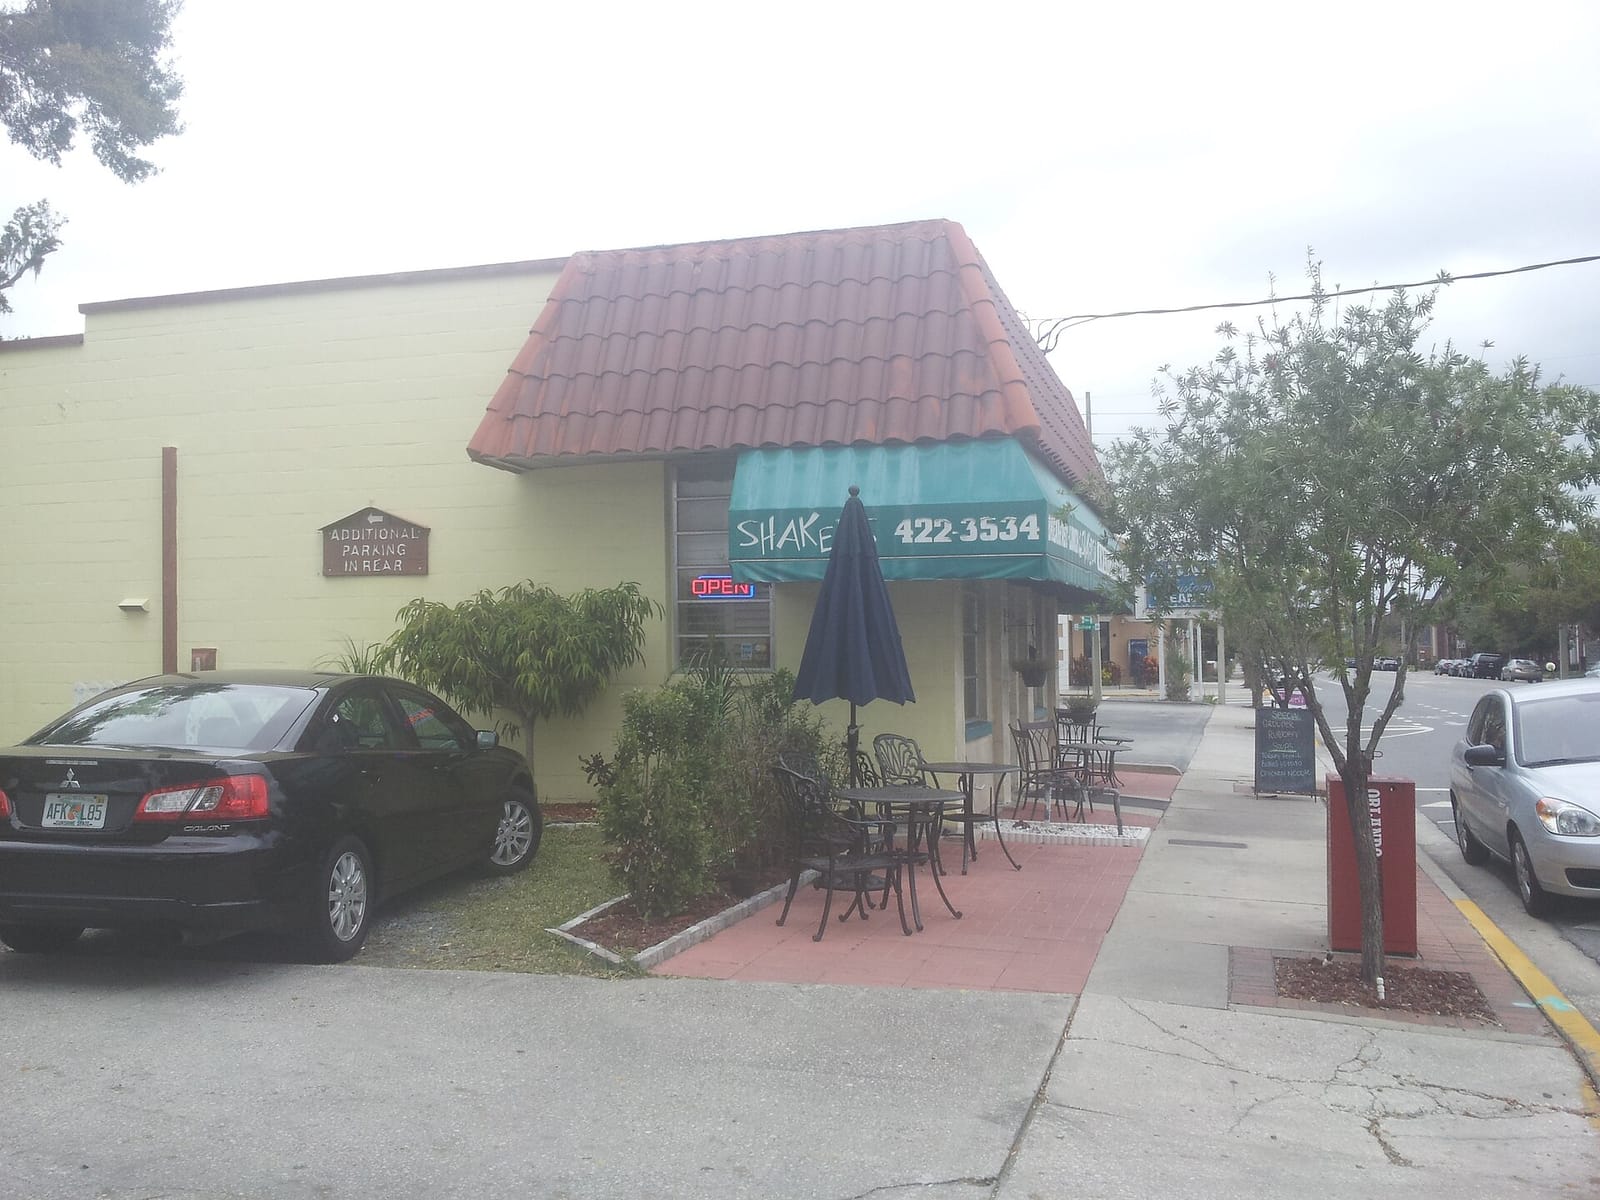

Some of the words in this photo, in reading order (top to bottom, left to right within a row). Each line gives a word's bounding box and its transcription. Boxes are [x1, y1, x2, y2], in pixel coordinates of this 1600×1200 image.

[330, 528, 420, 541] ADDITIONAL
[737, 511, 878, 556] SHAKE
[894, 513, 1040, 544] 422-3534
[342, 544, 407, 556] PARKING
[344, 560, 358, 572] IN
[363, 559, 402, 572] REAR
[692, 578, 750, 595] OPEN
[46, 803, 69, 819] AFK
[80, 804, 103, 820] L85
